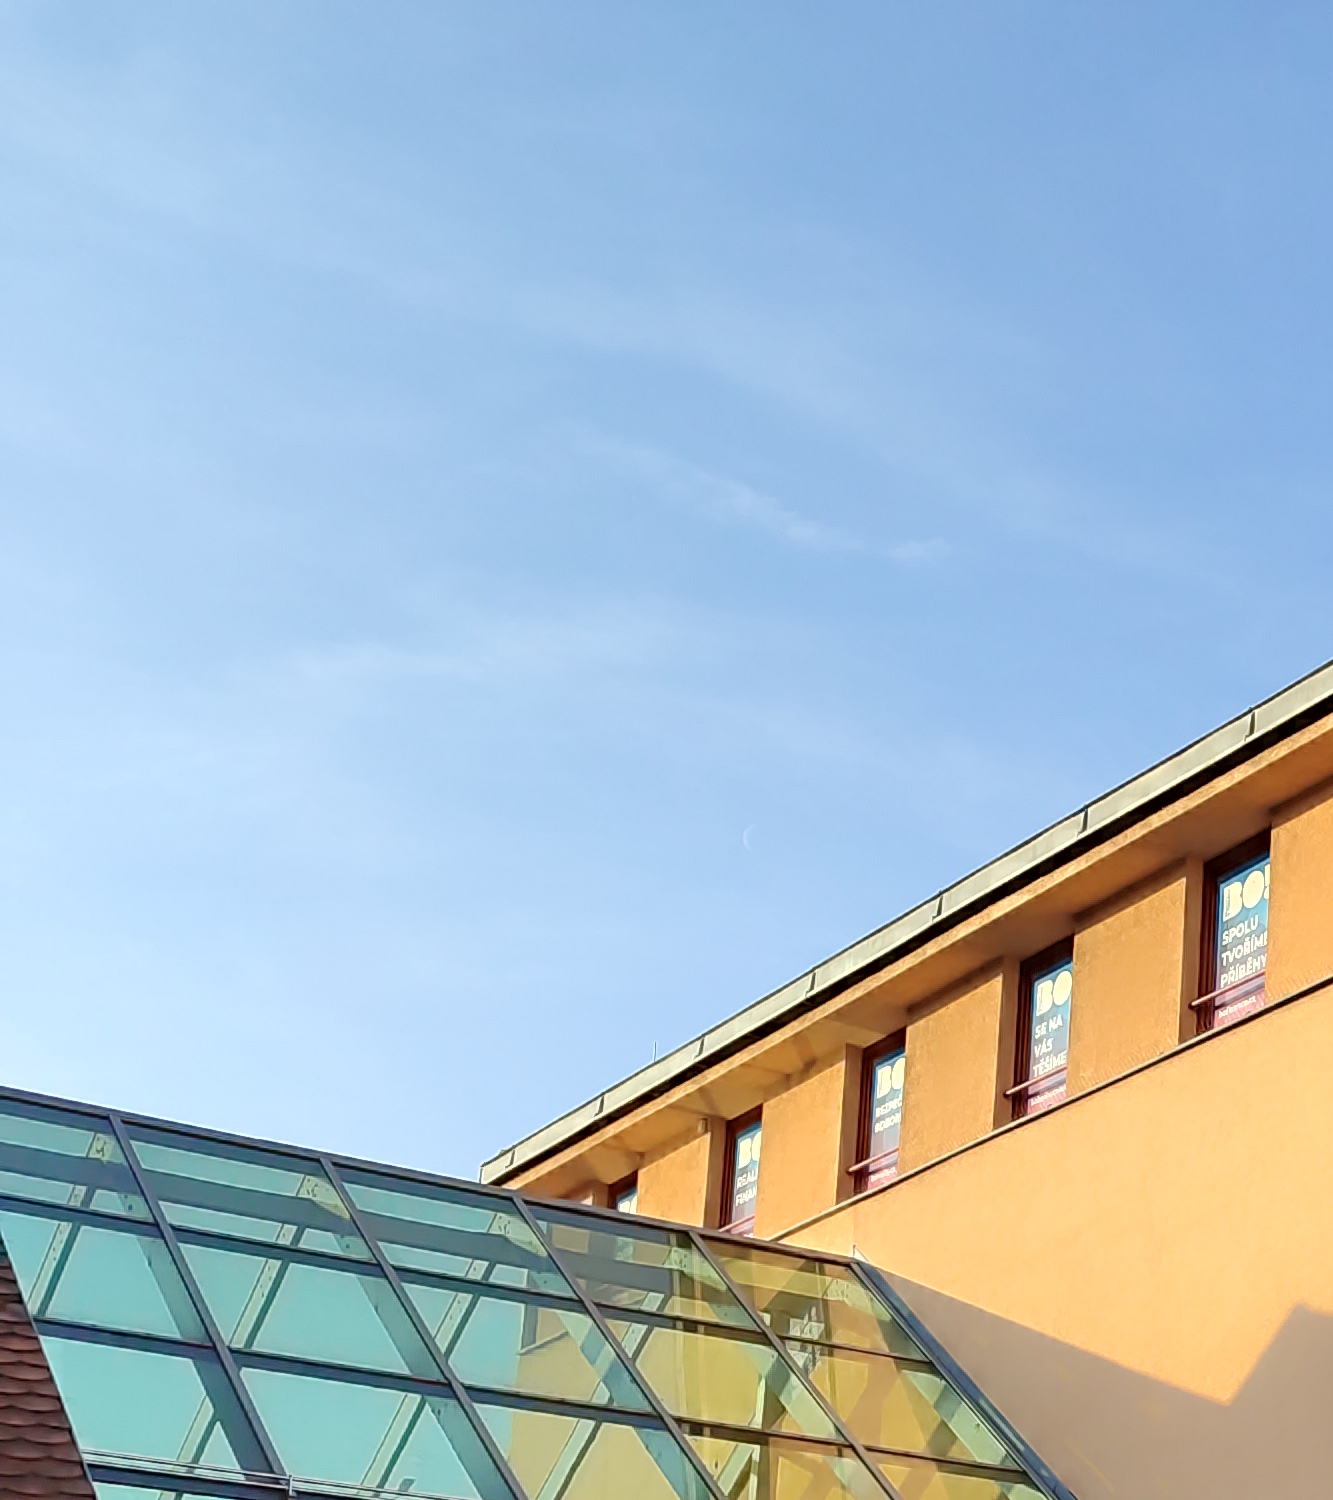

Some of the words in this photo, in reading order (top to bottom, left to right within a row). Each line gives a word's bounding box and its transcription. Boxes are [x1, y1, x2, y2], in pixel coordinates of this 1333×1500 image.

[1223, 864, 1270, 922] BO!
[1222, 914, 1259, 946] SPOLU
[1221, 931, 1268, 967] TVOŘÍME
[1221, 953, 1268, 989] PŘÍBĚHY
[1034, 1021, 1047, 1039] SE
[1048, 1013, 1063, 1033] NA
[1034, 1037, 1053, 1058] VÁS
[1033, 1050, 1067, 1078] TĚŠÍME
